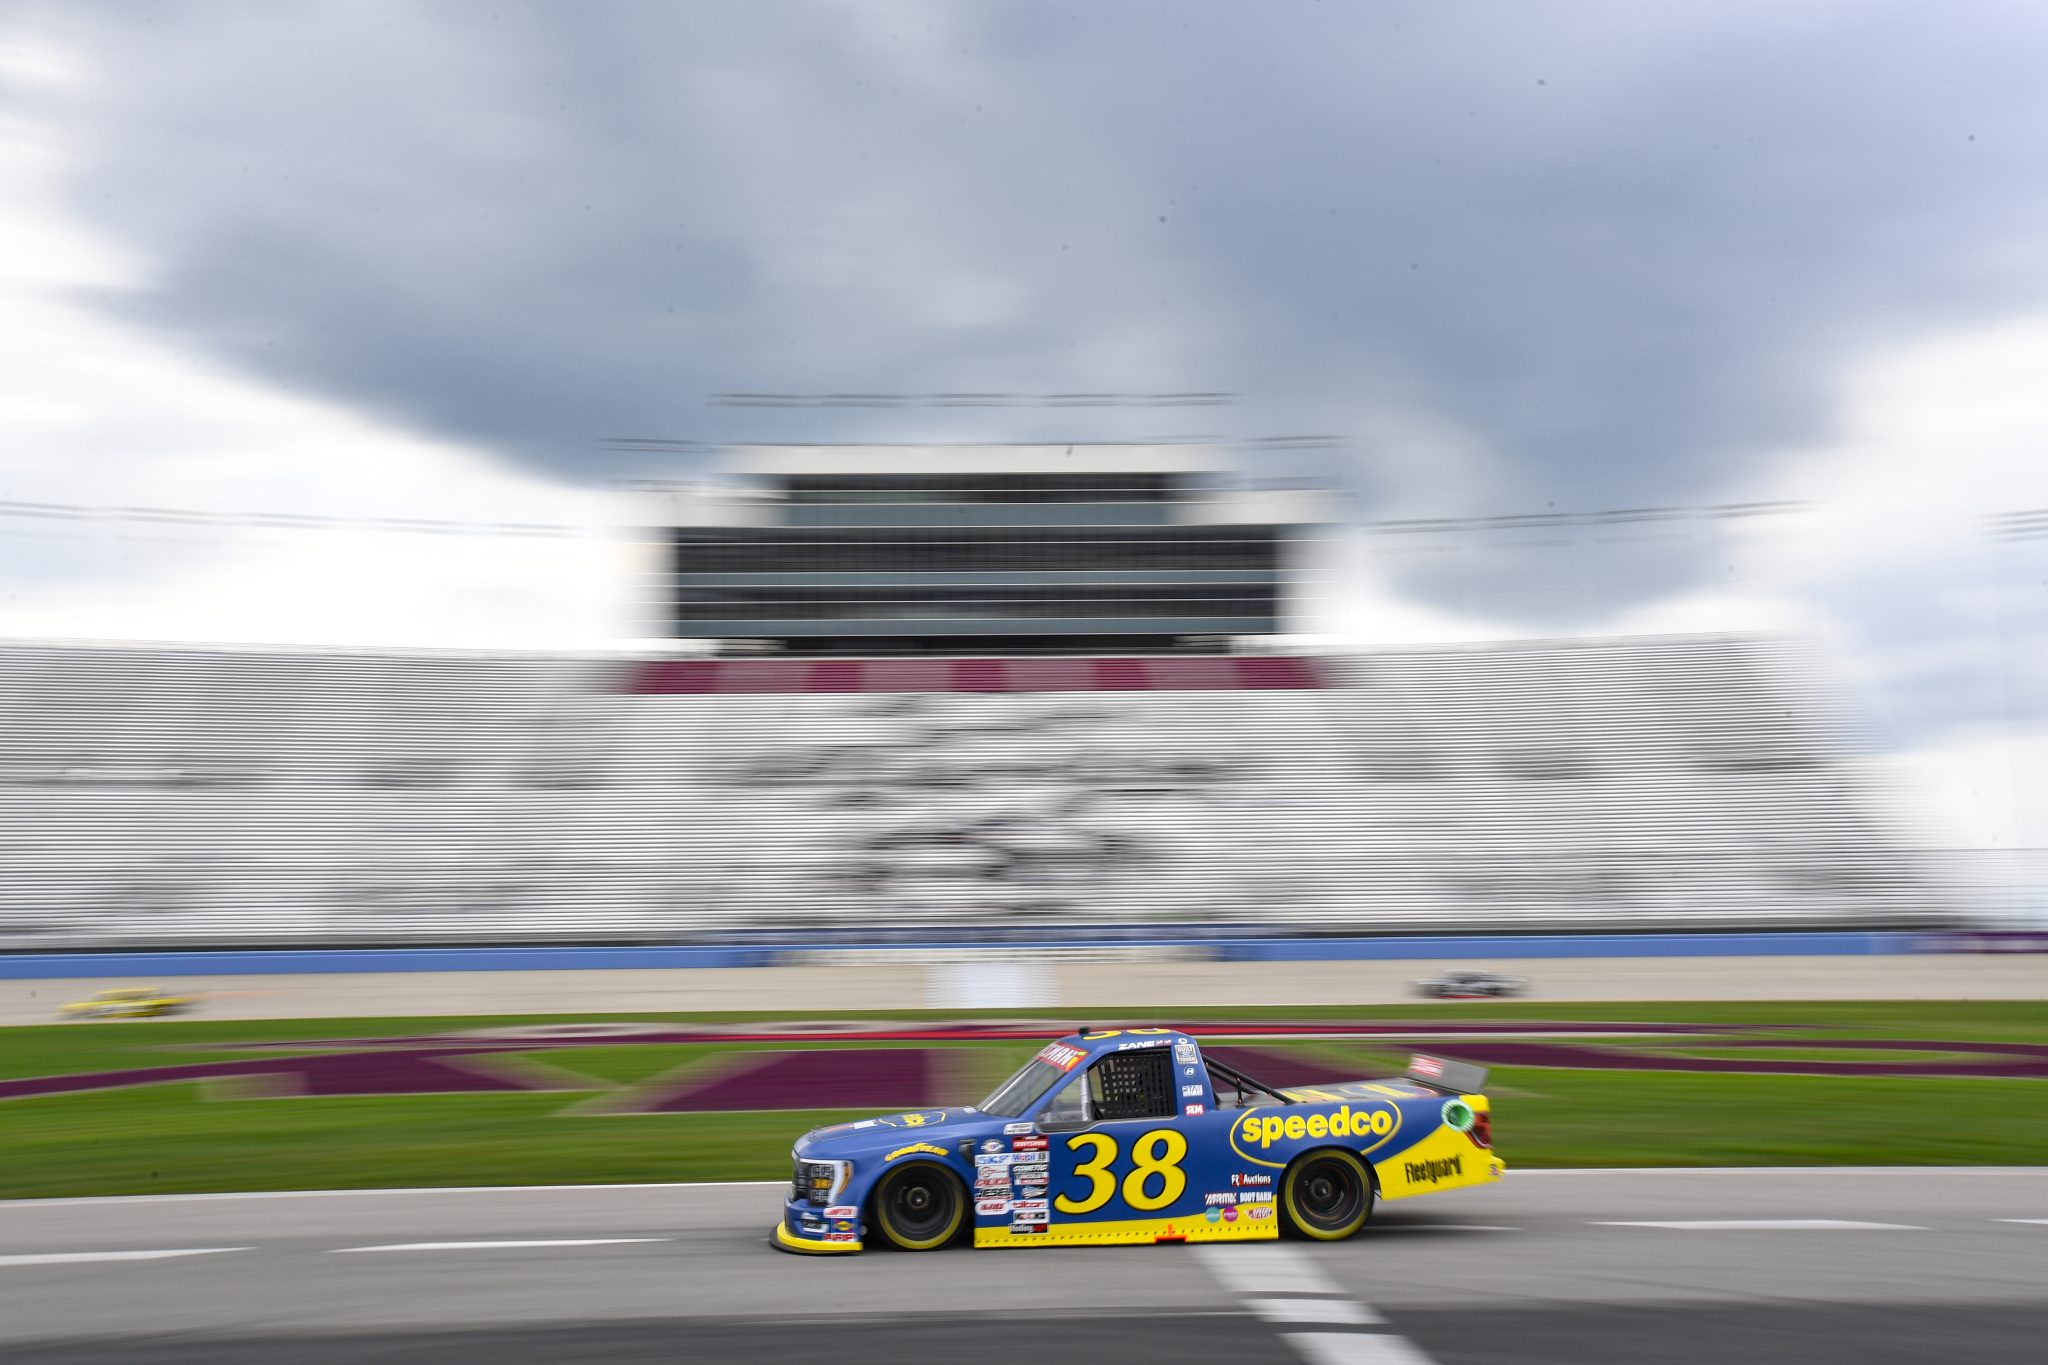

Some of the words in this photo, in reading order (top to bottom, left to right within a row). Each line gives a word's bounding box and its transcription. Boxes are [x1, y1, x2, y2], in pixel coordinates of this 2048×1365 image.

[1118, 1039, 1156, 1051] ZANE
[1241, 1105, 1393, 1149] speedco
[1053, 1128, 1188, 1214] 38
